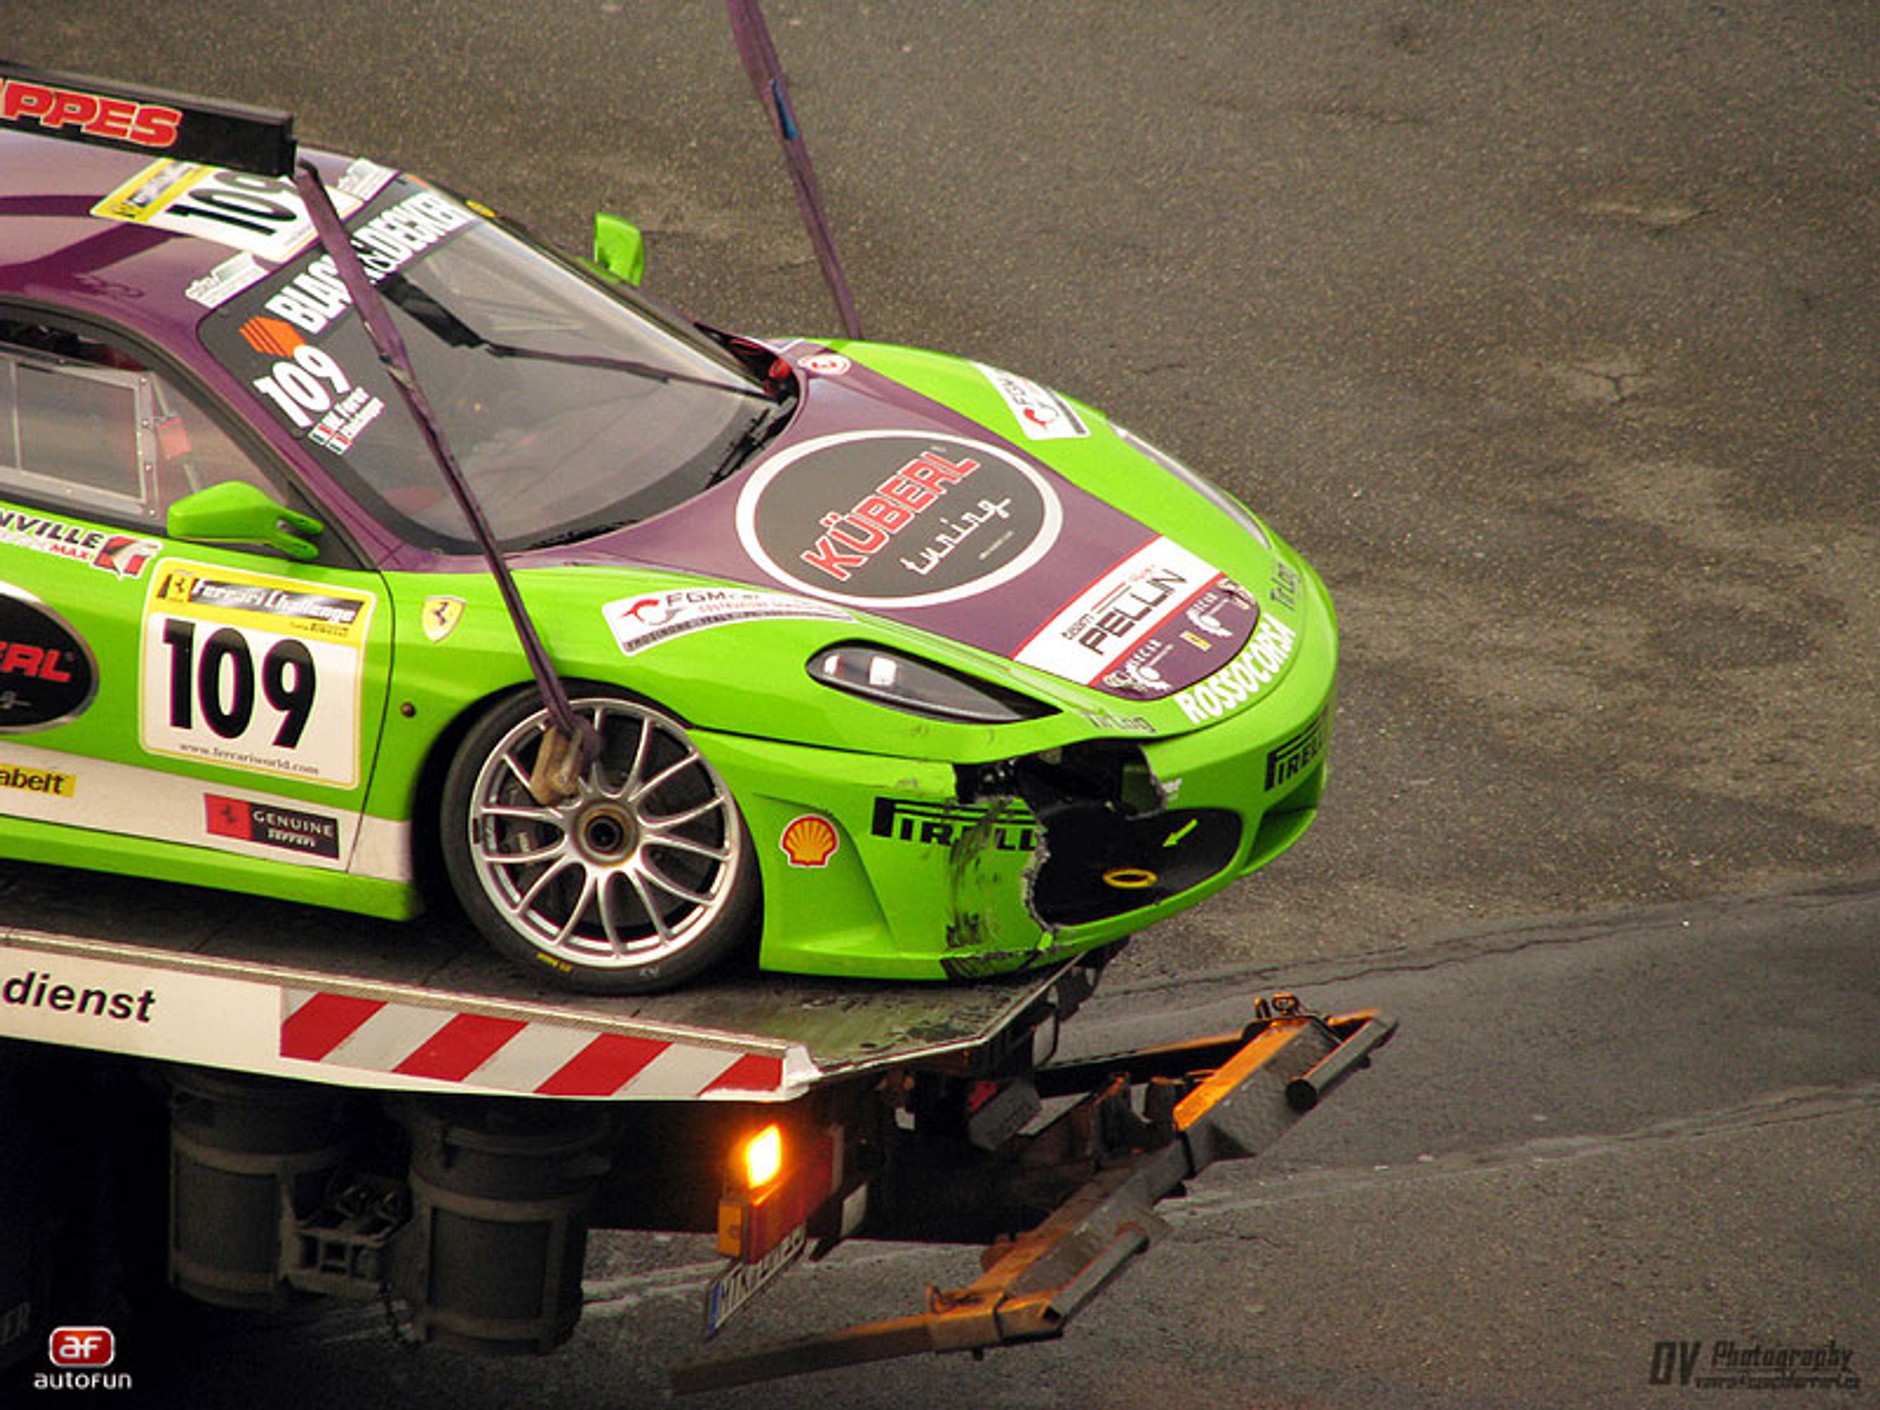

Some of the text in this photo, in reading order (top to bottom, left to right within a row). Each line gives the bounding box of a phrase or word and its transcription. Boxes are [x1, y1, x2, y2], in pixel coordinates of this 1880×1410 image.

[0, 79, 183, 147] PPES
[253, 345, 350, 428] 109
[800, 451, 981, 581] KÜBERL
[900, 498, 1011, 575] tuning
[163, 618, 316, 749] 109
[1174, 612, 1296, 724] ROSSOCORSA
[252, 810, 334, 838] GENUINE
[3, 971, 156, 1023] dienst
